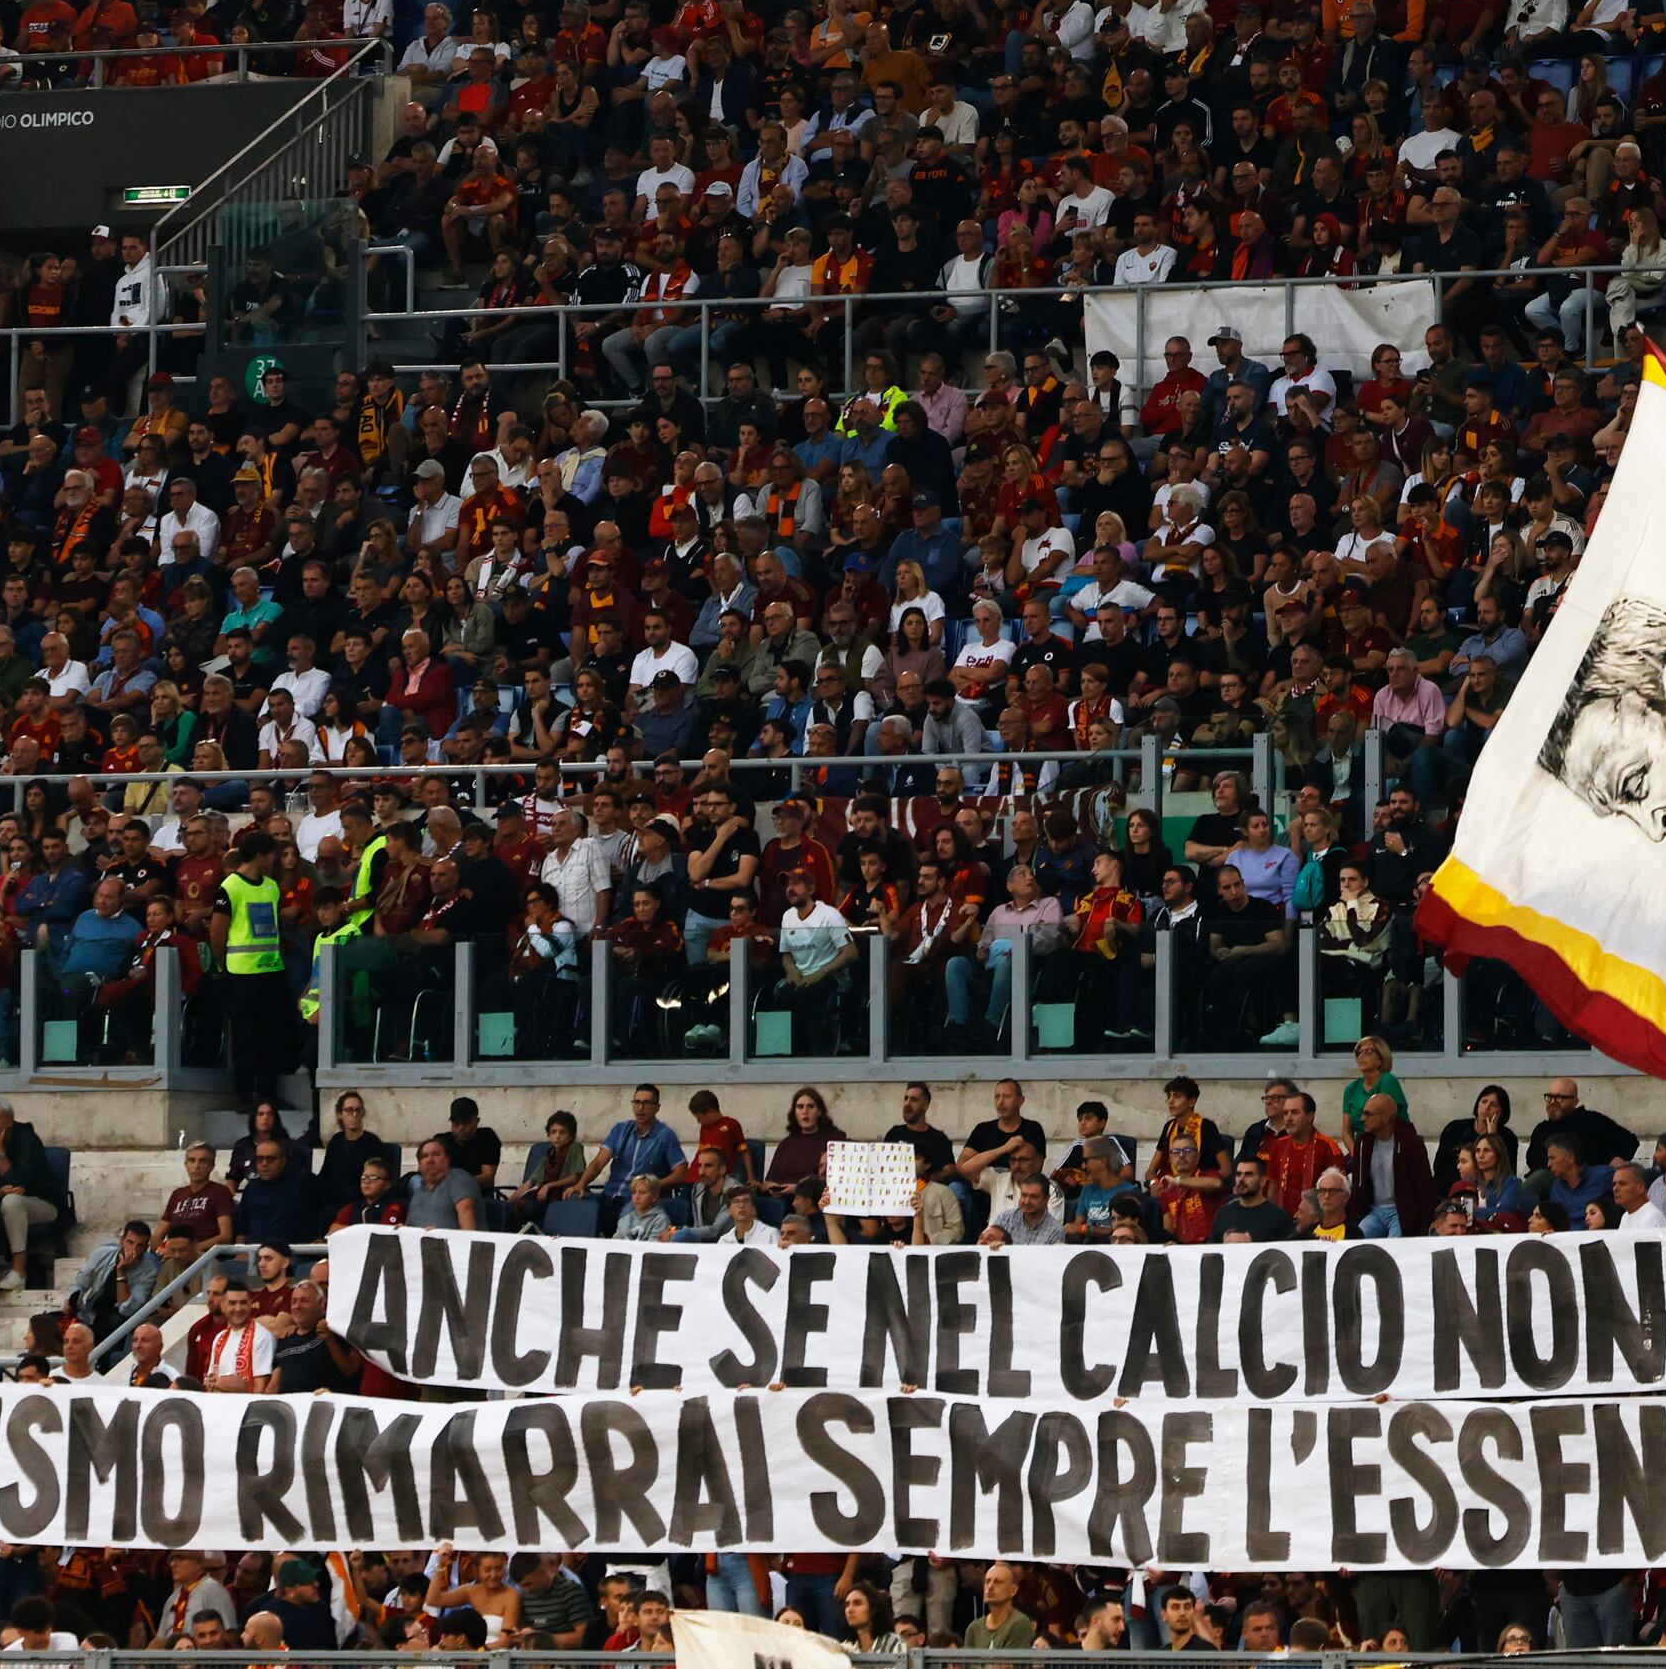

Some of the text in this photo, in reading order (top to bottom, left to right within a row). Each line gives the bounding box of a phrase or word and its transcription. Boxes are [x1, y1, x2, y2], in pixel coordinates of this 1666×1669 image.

[19, 110, 94, 129] OLIMPICO
[347, 1234, 698, 1391] ANCHE
[709, 1248, 836, 1391] SE
[860, 1251, 1032, 1397] NEL
[1060, 1244, 1404, 1400] CALCIO
[1432, 1240, 1666, 1392] NON
[236, 1392, 774, 1549] RIMARRAI
[796, 1393, 1213, 1571] SEMPRE
